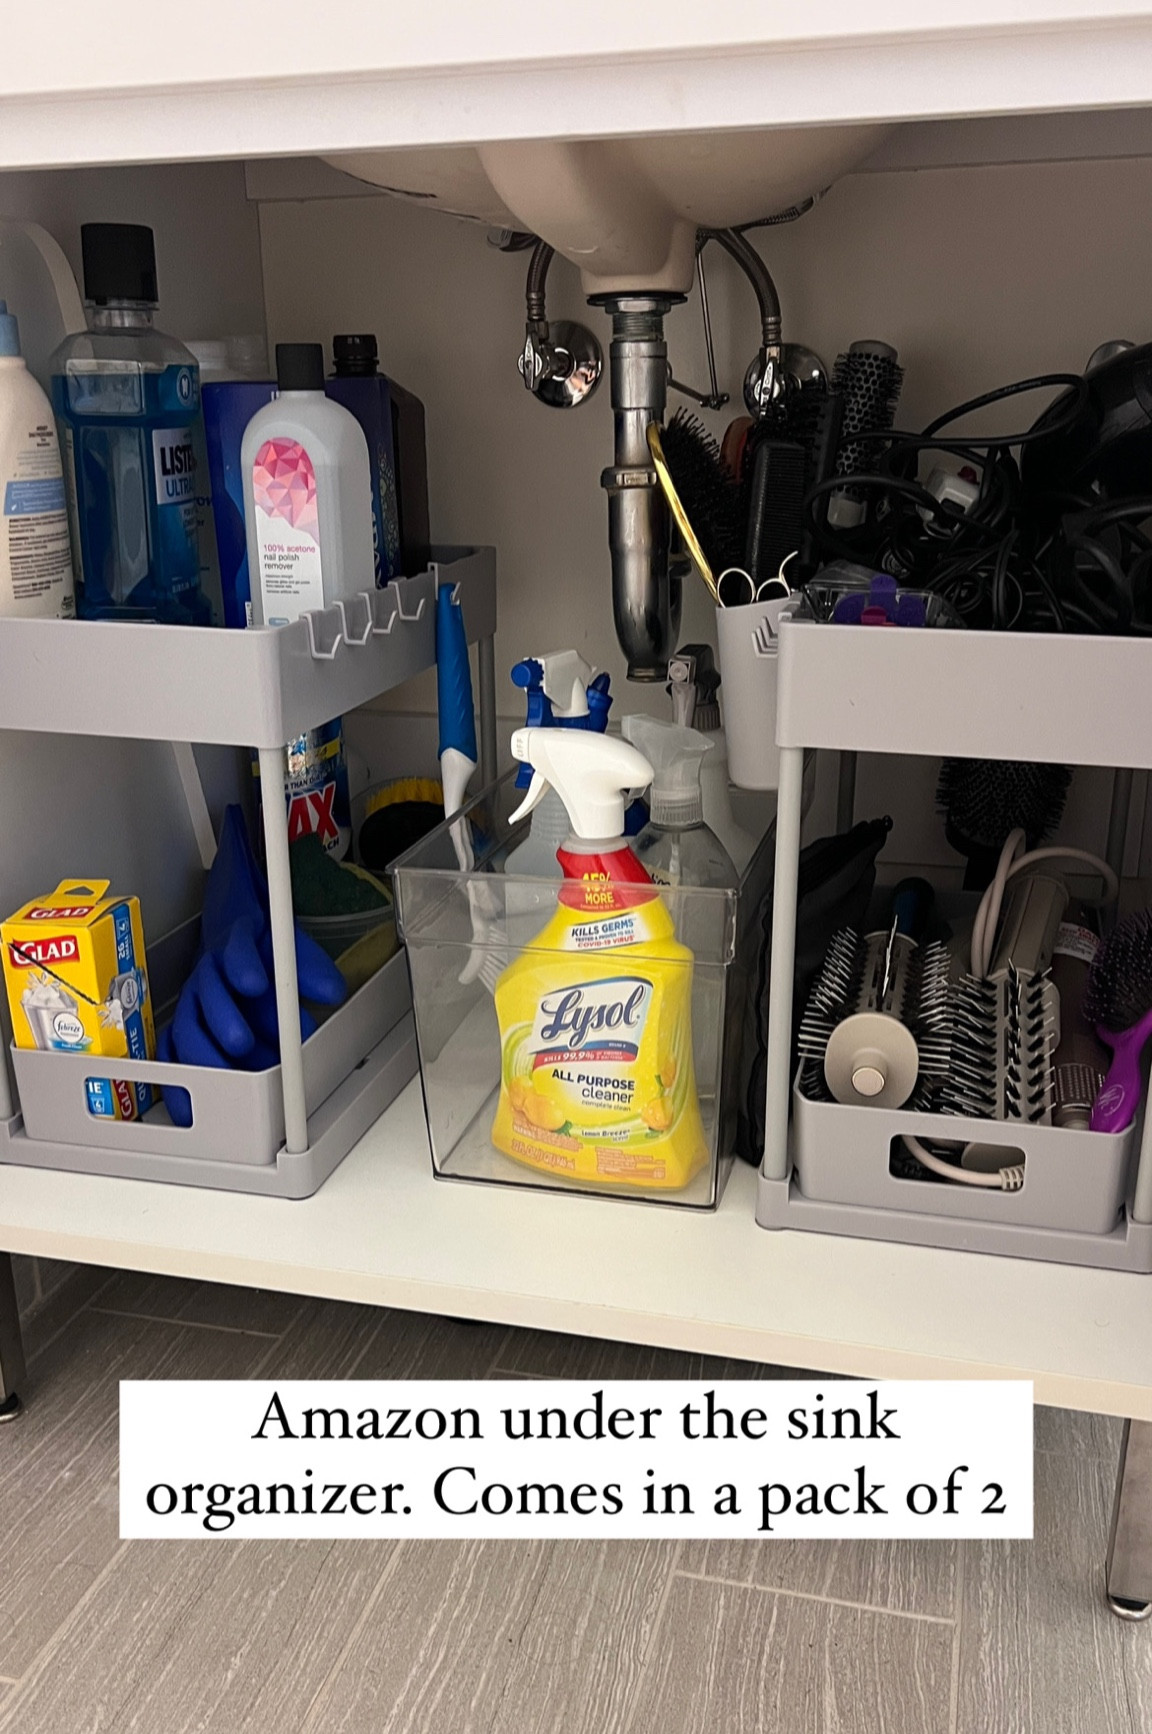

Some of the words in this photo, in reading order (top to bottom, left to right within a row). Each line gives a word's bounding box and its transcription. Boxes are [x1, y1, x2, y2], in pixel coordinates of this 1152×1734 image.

[264, 544, 284, 553] 100%
[287, 545, 316, 554] acetone
[264, 553, 276, 561] nail
[278, 553, 300, 562] polish
[585, 892, 614, 904] MORE
[31, 907, 90, 919] GLAD
[572, 925, 599, 937] KILLS
[602, 918, 634, 933] GERMS
[578, 939, 611, 948] COVID-19
[13, 939, 76, 965] GLAD
[541, 984, 644, 1048] Lysol
[563, 1051, 594, 1061] 99.9%
[552, 1068, 574, 1083] ALL
[577, 1074, 635, 1091] PURPOSE
[116, 1080, 132, 1117] GLA
[582, 1086, 634, 1104] cleaner
[582, 1100, 612, 1110] complete
[614, 1104, 631, 1112] clean
